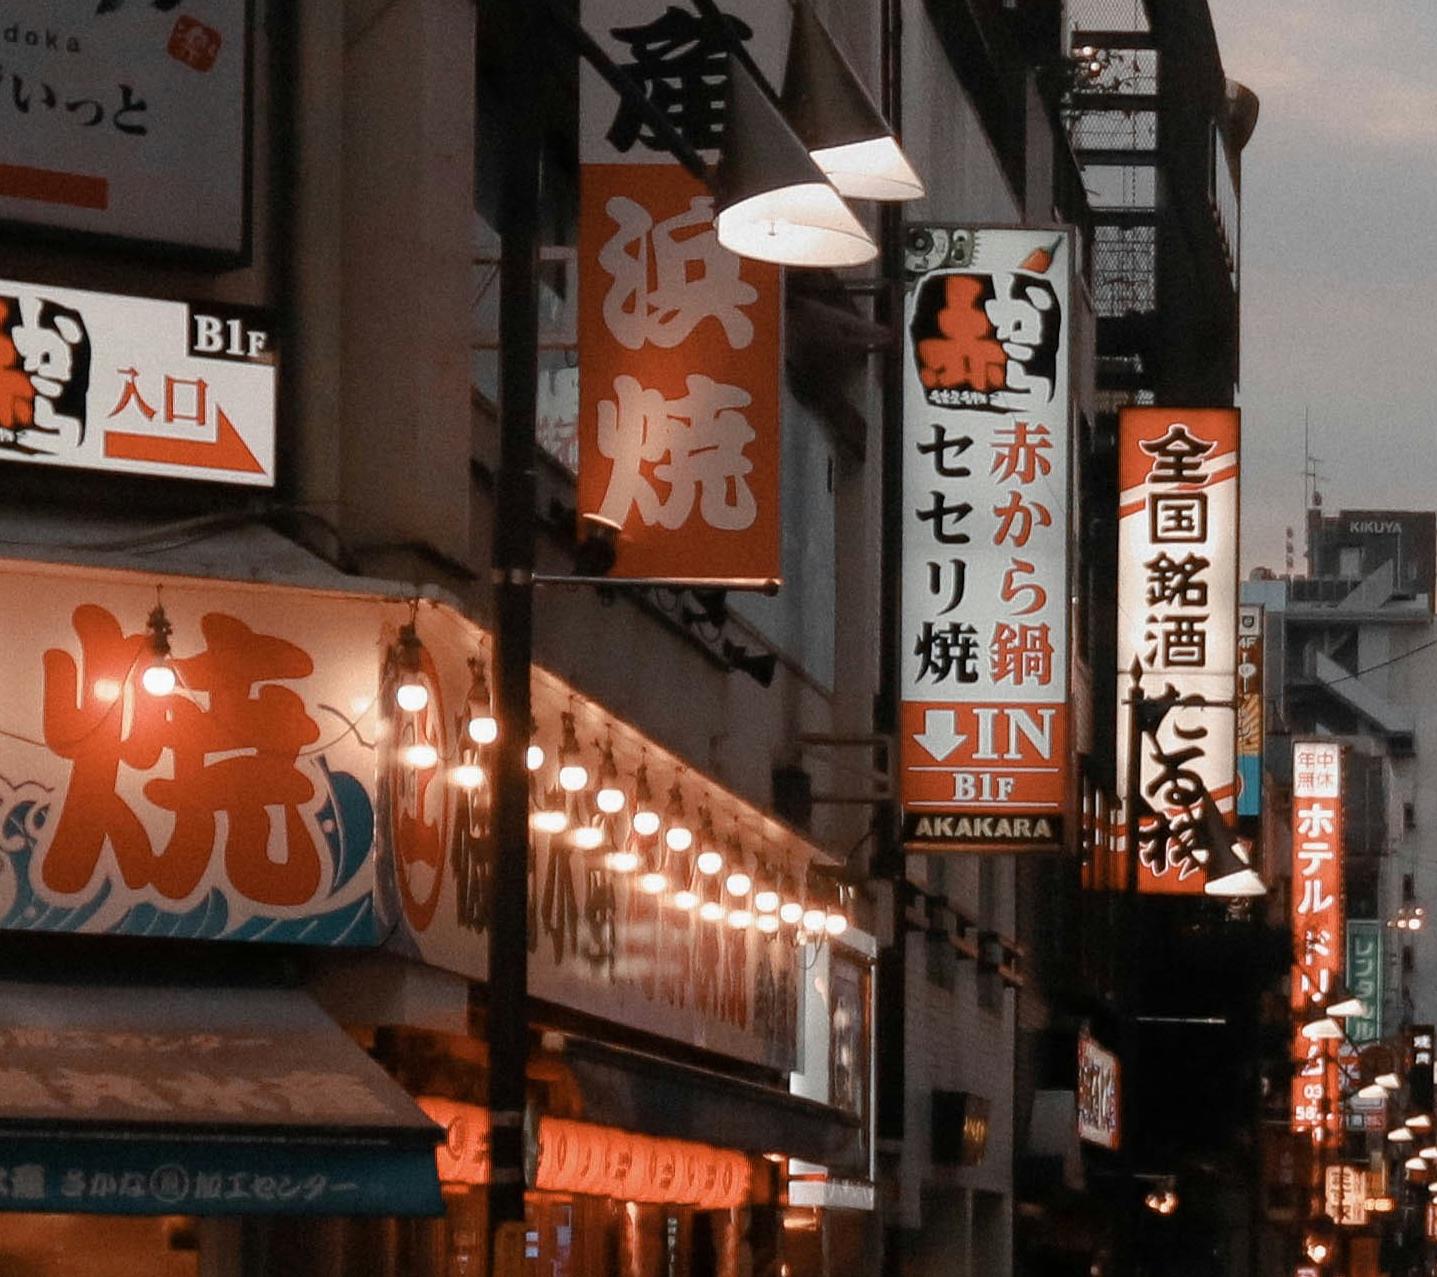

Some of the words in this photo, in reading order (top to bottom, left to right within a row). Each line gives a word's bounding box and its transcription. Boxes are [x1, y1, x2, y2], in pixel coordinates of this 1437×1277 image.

[193, 313, 269, 359] B1F
[596, 195, 759, 532] 浜焼
[107, 368, 209, 427] 入口
[988, 421, 1052, 687] 赤から鍋
[1139, 424, 1219, 670] 全国銘酒
[1349, 521, 1403, 534] KIKUYA
[914, 425, 980, 687] セセリ焼
[971, 708, 1052, 763] IN
[1297, 751, 1334, 768] 年中
[953, 771, 1015, 802] B1F
[914, 814, 1052, 841] AKAKARA
